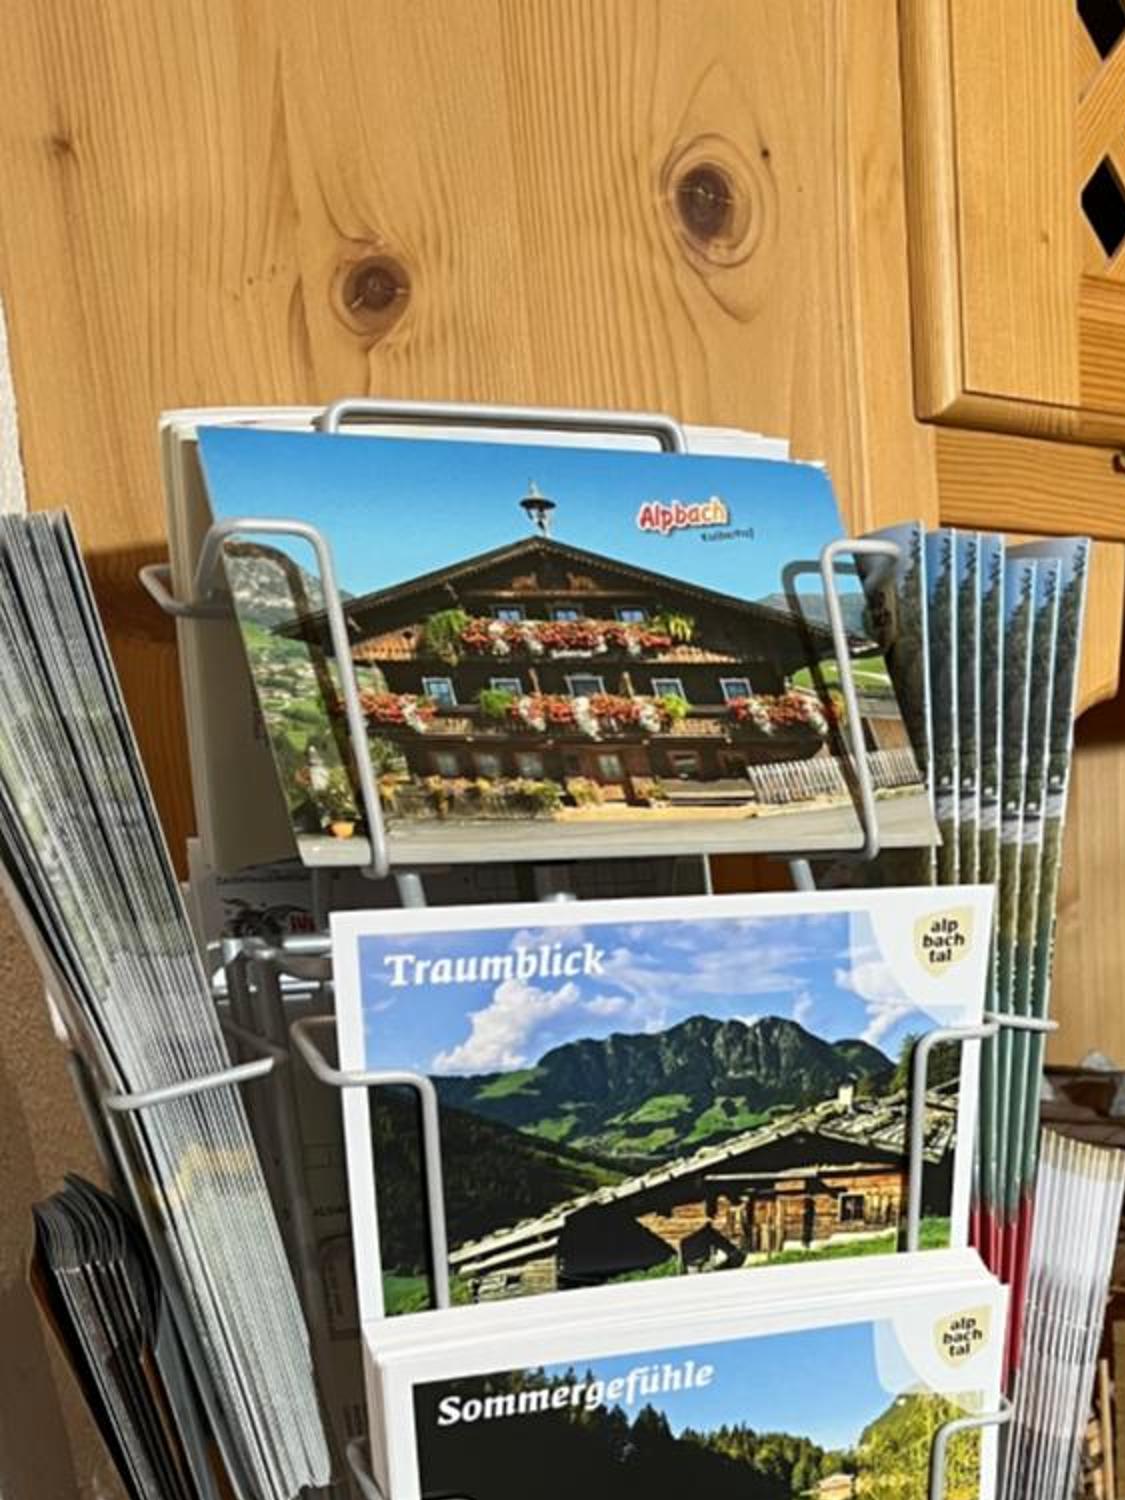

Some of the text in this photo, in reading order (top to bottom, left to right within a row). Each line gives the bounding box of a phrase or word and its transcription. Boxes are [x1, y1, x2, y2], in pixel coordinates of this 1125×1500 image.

[639, 499, 727, 532] Alpbach
[931, 918, 958, 933] alp
[922, 933, 965, 948] bach
[929, 949, 952, 963] tal
[384, 943, 605, 986] Traumblick
[950, 1317, 976, 1331] alp
[943, 1328, 982, 1344] bach
[949, 1342, 970, 1357] tal
[437, 1360, 714, 1426] Sommergefühle
